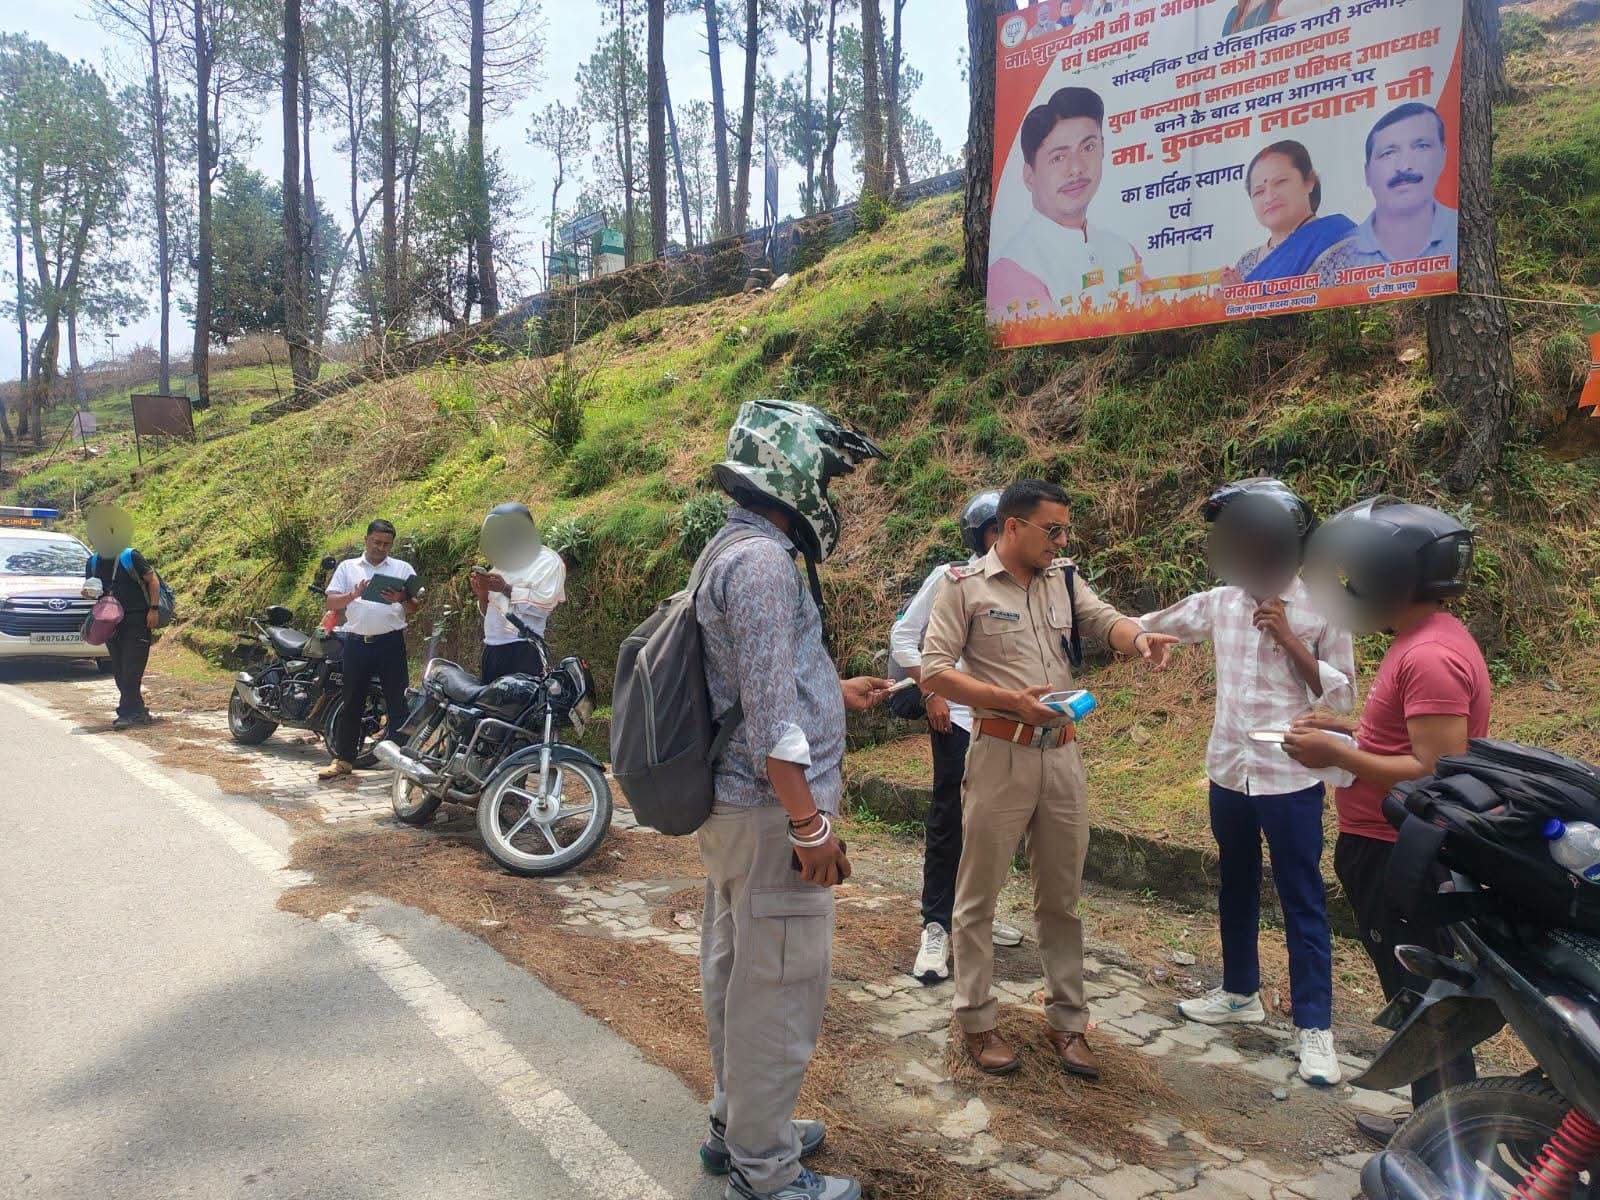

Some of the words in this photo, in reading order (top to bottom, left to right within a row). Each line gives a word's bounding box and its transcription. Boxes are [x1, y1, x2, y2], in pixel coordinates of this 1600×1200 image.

[1032, 21, 1105, 66] मुख्यमंत्री
[1107, 12, 1130, 34] जी
[1132, 7, 1155, 27] का
[1061, 49, 1083, 71] एवं
[1086, 32, 1150, 62] धन्यवाद
[1111, 55, 1181, 87] सांस्कृतिक
[1186, 45, 1209, 66] एवं
[1213, 23, 1297, 57] ऐतिहासिक
[1300, 7, 1342, 31] नगरी
[1175, 65, 1217, 89] राज्य
[1220, 49, 1257, 74] मंत्री
[1260, 27, 1351, 66] उत्तराखण्ड
[1108, 110, 1137, 133] युवा
[1140, 92, 1202, 120] कल्याण
[1204, 68, 1290, 104] सलाहकार
[1356, 26, 1441, 64] उपाध्यक्ष
[1111, 142, 1154, 166] मा.
[1160, 116, 1253, 163] कुन्दन
[1258, 86, 1378, 133] लटवाल
[1384, 65, 1434, 101] जी
[1154, 113, 1188, 133] बनने
[1190, 109, 1208, 125] के
[1210, 102, 1241, 120] बाद
[1245, 91, 1284, 112] प्रथम
[1288, 75, 1348, 101] आगमन
[1351, 67, 1377, 84] पर
[1120, 186, 1142, 203] का
[1144, 170, 1192, 200] हार्दिक
[1195, 164, 1245, 188] स्वागत
[1169, 197, 1192, 219] एवं
[1147, 224, 1214, 249] अभिनन्दन
[1224, 282, 1264, 300] ममता
[1265, 273, 1321, 294] कनवाल
[1334, 263, 1387, 286] आनन्द
[1389, 254, 1452, 277] कनवाल
[1226, 303, 1244, 315] जिला
[1245, 301, 1268, 313] पंचायत
[1269, 298, 1290, 310] सदस्य
